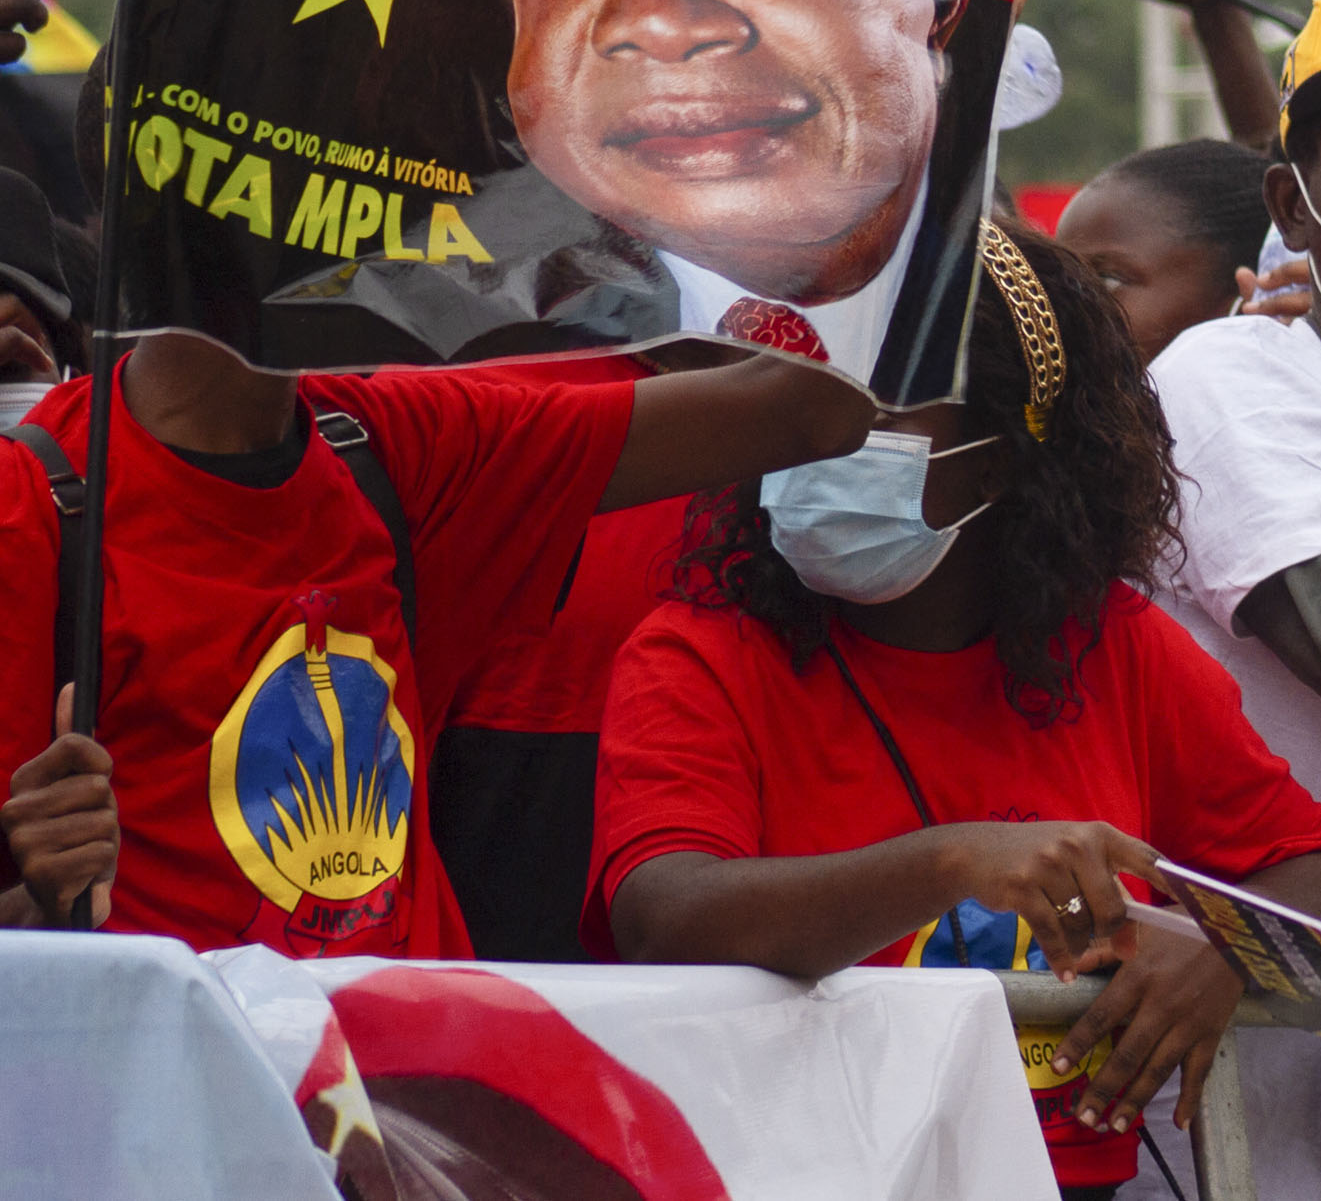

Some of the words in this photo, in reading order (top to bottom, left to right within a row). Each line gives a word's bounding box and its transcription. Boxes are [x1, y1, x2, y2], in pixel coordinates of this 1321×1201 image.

[124, 114, 272, 239] OTA
[284, 172, 495, 264] MPLA
[161, 84, 221, 126] COM
[226, 111, 249, 135] O
[252, 119, 323, 166] POVO,
[324, 139, 375, 174] RUMO
[374, 146, 389, 178] À
[393, 157, 474, 196] VITÓRIA
[309, 851, 389, 886] ANGOLA
